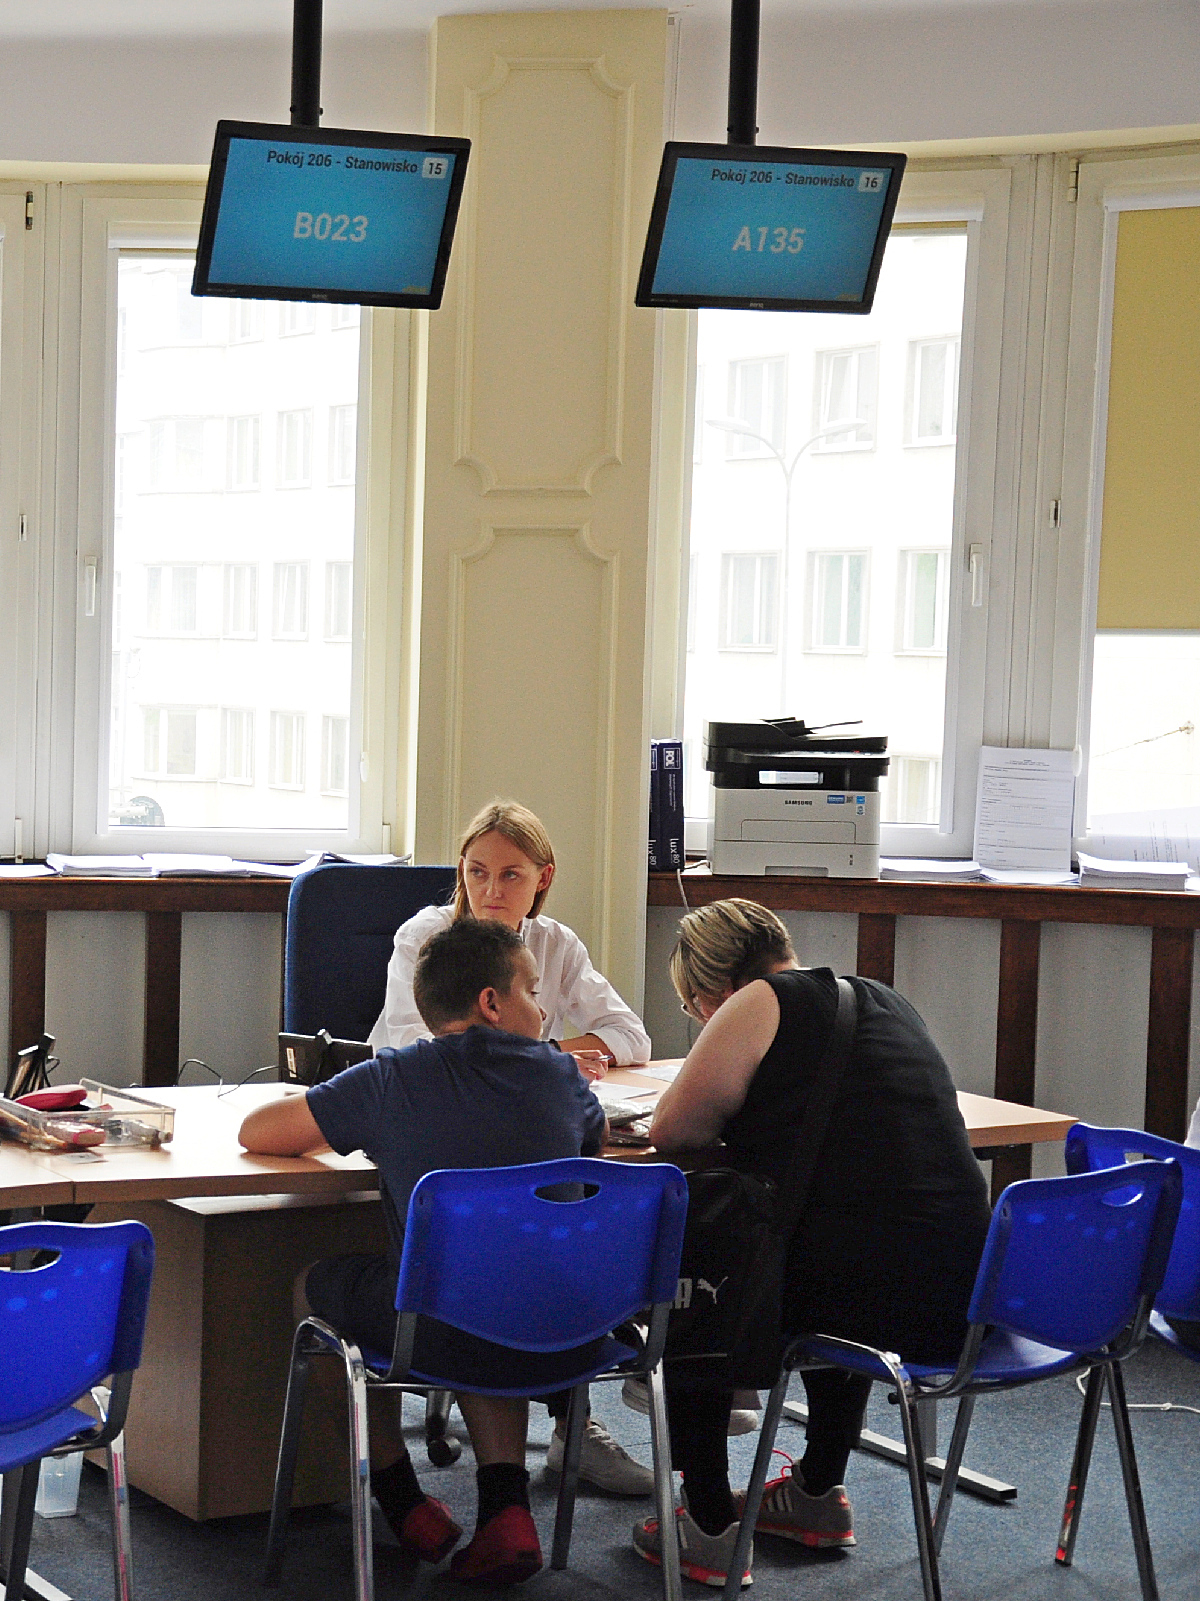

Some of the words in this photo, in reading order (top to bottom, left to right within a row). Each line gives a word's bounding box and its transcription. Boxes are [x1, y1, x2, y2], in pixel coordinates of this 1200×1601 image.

[266, 150, 304, 168] Pokój
[307, 154, 332, 168] 206
[345, 156, 418, 174] Stanowisko
[427, 162, 443, 176] 15
[711, 168, 747, 185] Pokój
[749, 171, 773, 184] 206
[785, 173, 855, 188] Stanowisko
[863, 176, 879, 189] 16
[293, 212, 369, 243] B023
[732, 226, 807, 255] A135
[665, 750, 675, 767] POL
